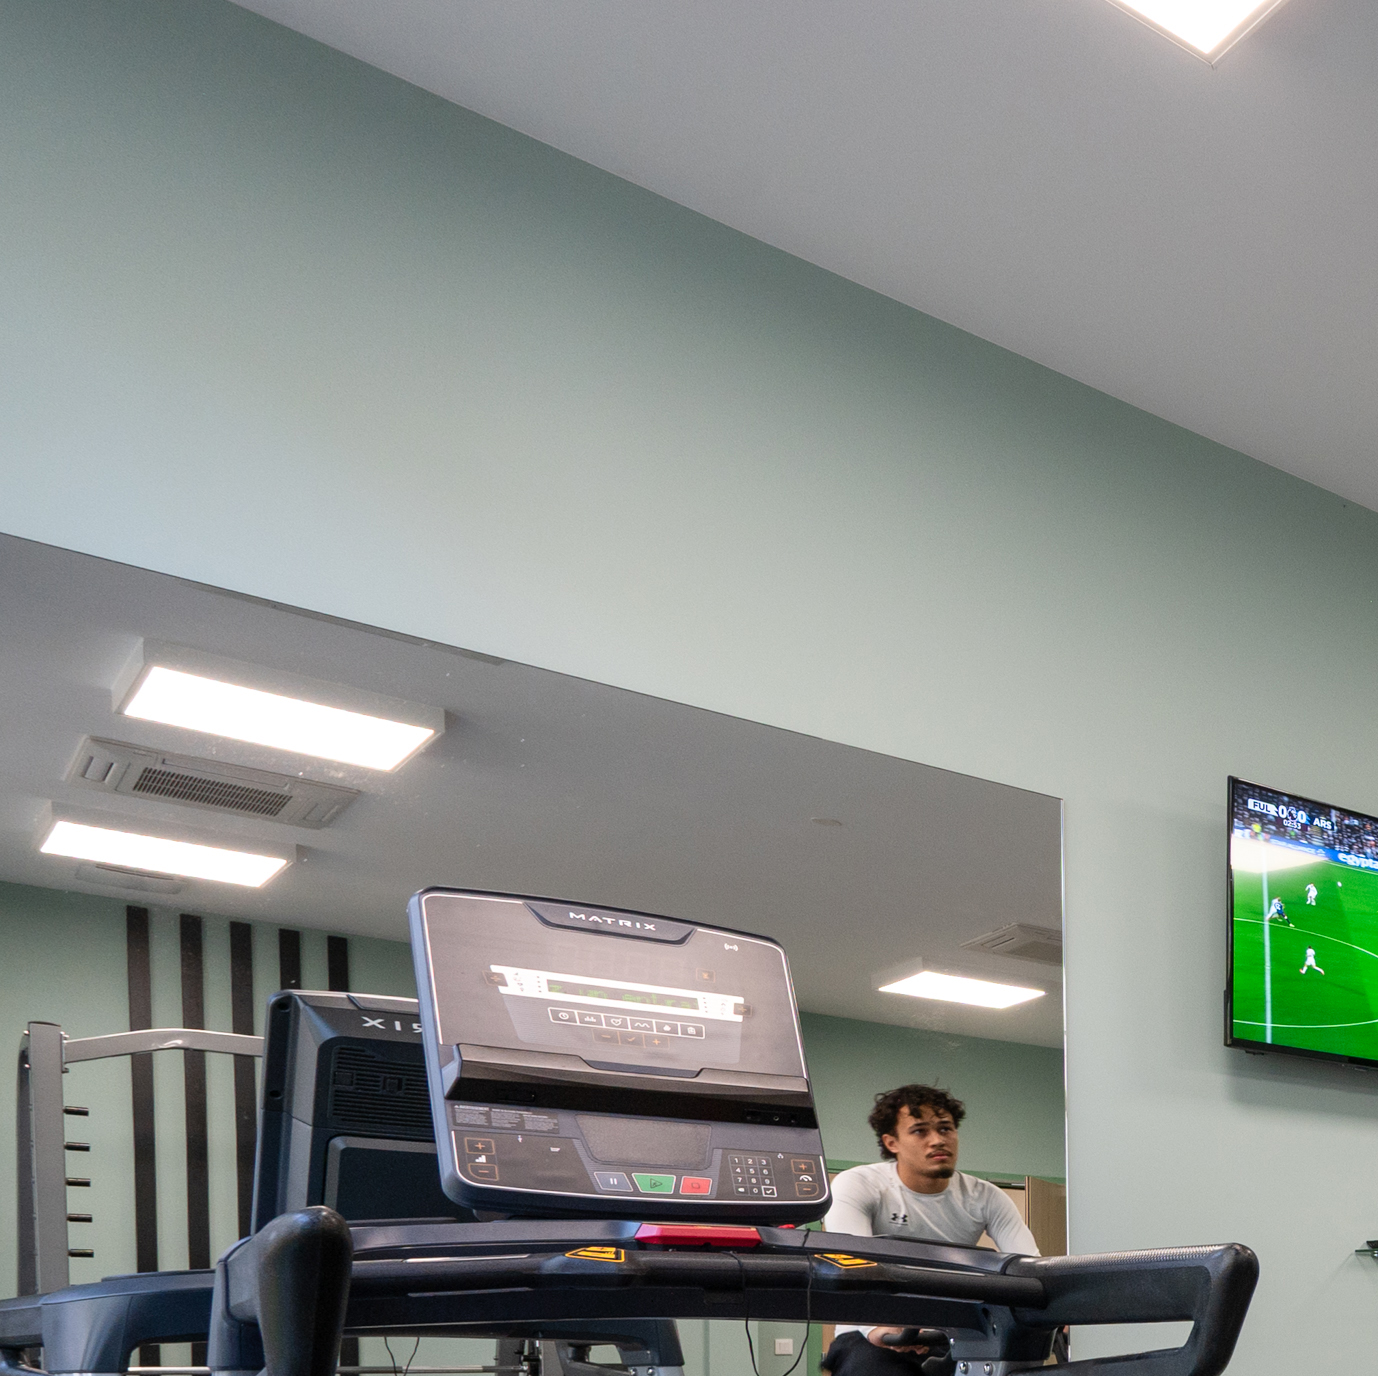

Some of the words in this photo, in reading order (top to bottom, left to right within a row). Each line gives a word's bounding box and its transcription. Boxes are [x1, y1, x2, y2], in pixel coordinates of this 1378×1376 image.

[1253, 801, 1271, 813] FUL
[1313, 818, 1332, 830] ARS
[568, 911, 657, 932] MATRIX
